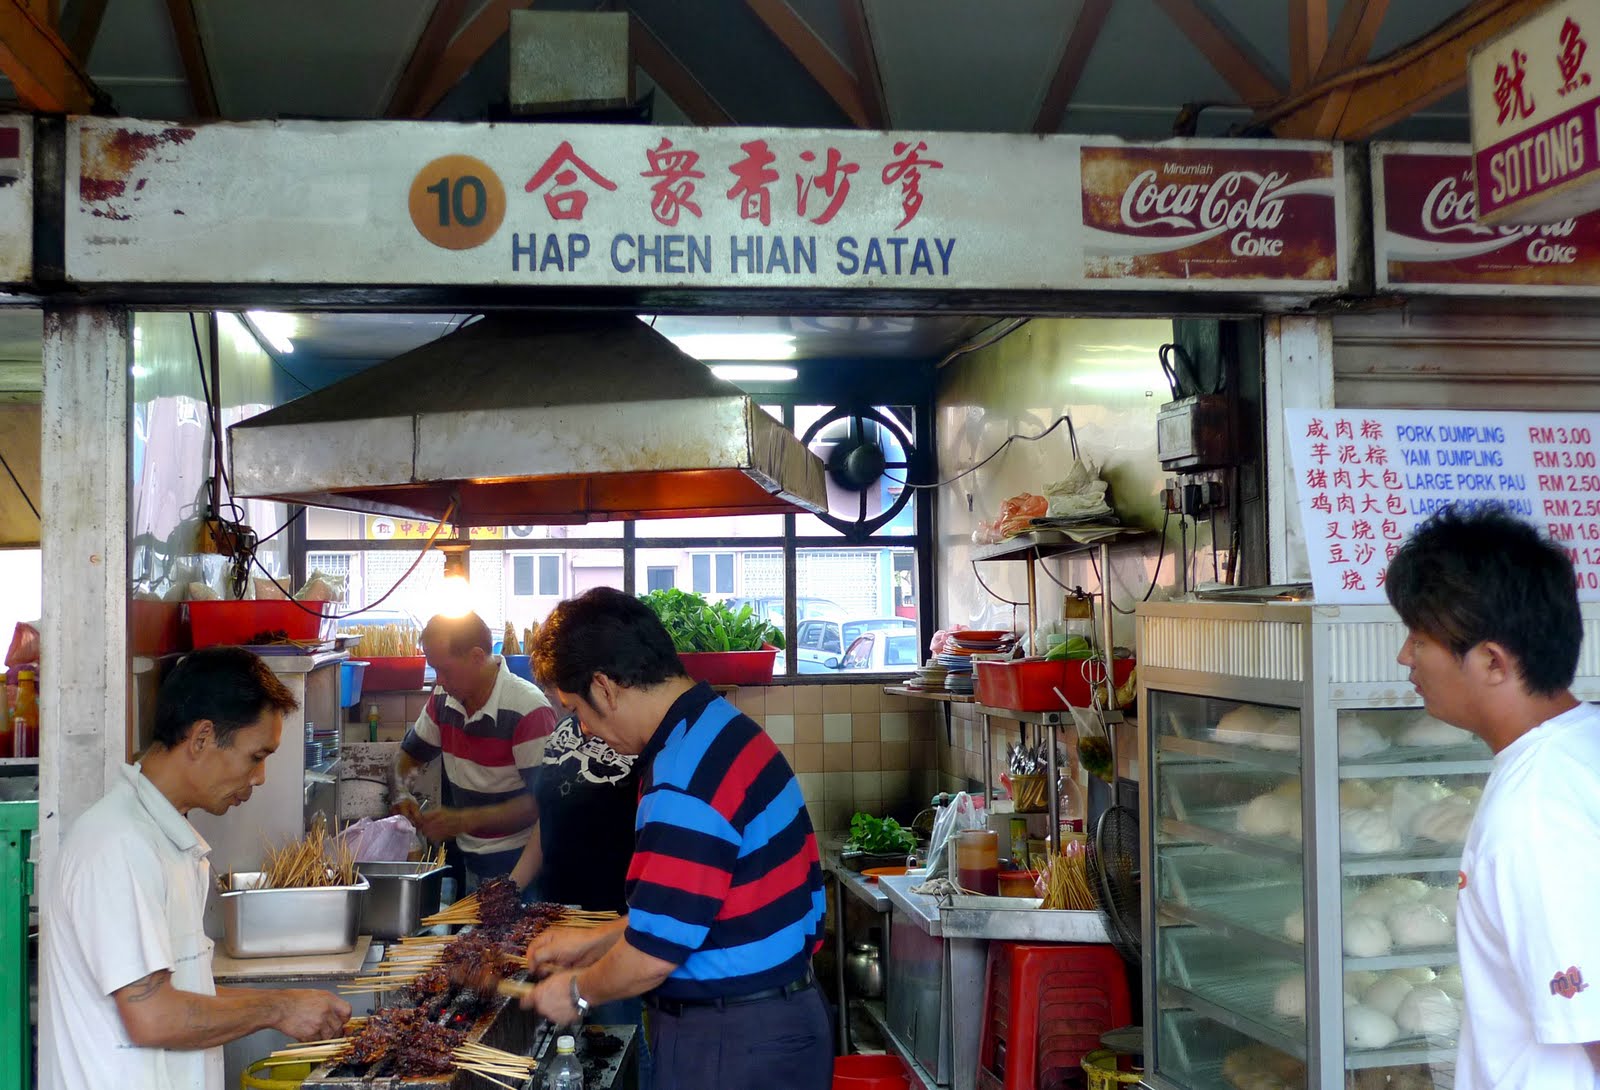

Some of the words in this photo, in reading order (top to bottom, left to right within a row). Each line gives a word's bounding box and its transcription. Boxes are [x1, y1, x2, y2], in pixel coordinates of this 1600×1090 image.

[1163, 162, 1213, 175] Minumlah
[1490, 115, 1585, 204] SOTONG
[426, 176, 487, 227] 10
[1120, 169, 1289, 229] Coca-Cola
[511, 233, 590, 272] HAP
[611, 234, 712, 273] CHEN
[730, 236, 816, 273] HIAN
[837, 236, 956, 276] SATAY
[1230, 231, 1284, 257] Coke
[1526, 238, 1577, 264] Coke
[1306, 418, 1383, 441] 咸肉粽
[1397, 425, 1436, 442] PORK
[1440, 426, 1504, 443] DUMPLING
[1529, 427, 1555, 444] RM
[1557, 428, 1591, 444] 3.00
[1310, 443, 1388, 466] 芋泥粽
[1401, 449, 1430, 466] YAM
[1438, 450, 1503, 467] DUMPLING
[1534, 451, 1559, 468] RM
[1562, 452, 1596, 468] 3.00
[1307, 469, 1403, 490] 猪肉大包
[1406, 474, 1453, 490] LARGE
[1458, 474, 1494, 490] PORK
[1500, 474, 1526, 490] PAU
[1538, 474, 1564, 491] RM
[1567, 475, 1600, 491] 2.50
[1311, 493, 1407, 515] 鸡肉大包
[1508, 499, 1533, 515] PAU
[1543, 500, 1569, 516] RM
[1325, 518, 1403, 540] 叉烧包
[1548, 523, 1575, 540] RM
[1578, 523, 1600, 540] 1.6
[1328, 543, 1401, 564] 豆沙包
[1564, 548, 1579, 565] M
[1582, 548, 1600, 565] 1.2
